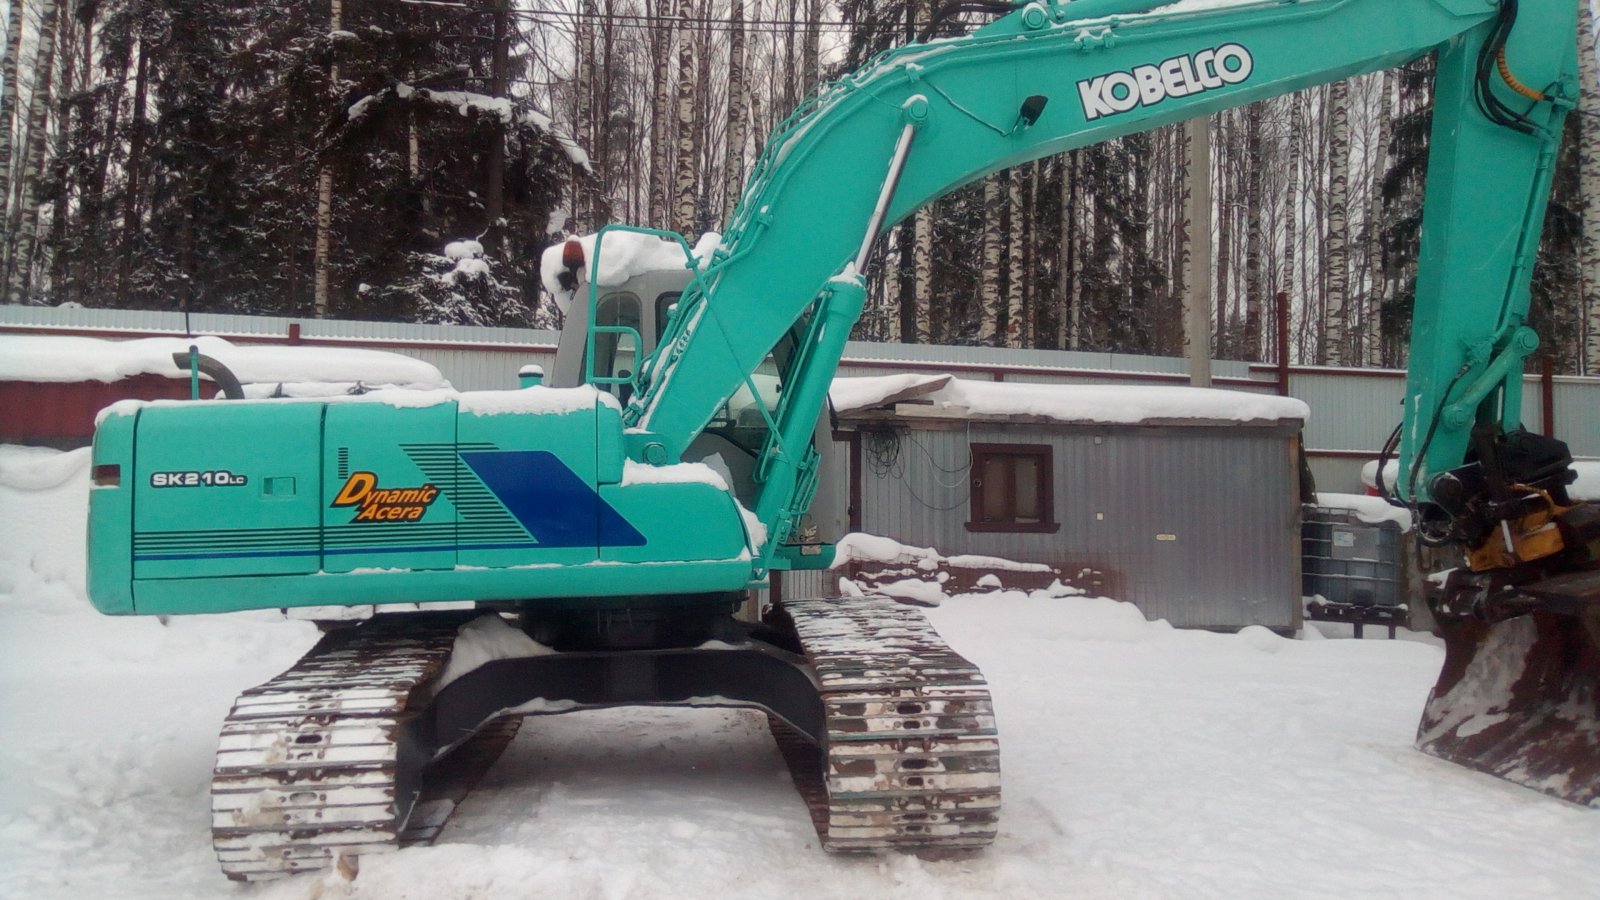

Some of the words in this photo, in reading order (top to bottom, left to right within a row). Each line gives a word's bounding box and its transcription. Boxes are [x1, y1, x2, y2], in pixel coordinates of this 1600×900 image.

[1077, 43, 1253, 121] KOBELCO
[335, 472, 437, 507] Dynamic
[356, 503, 424, 520] Acera
